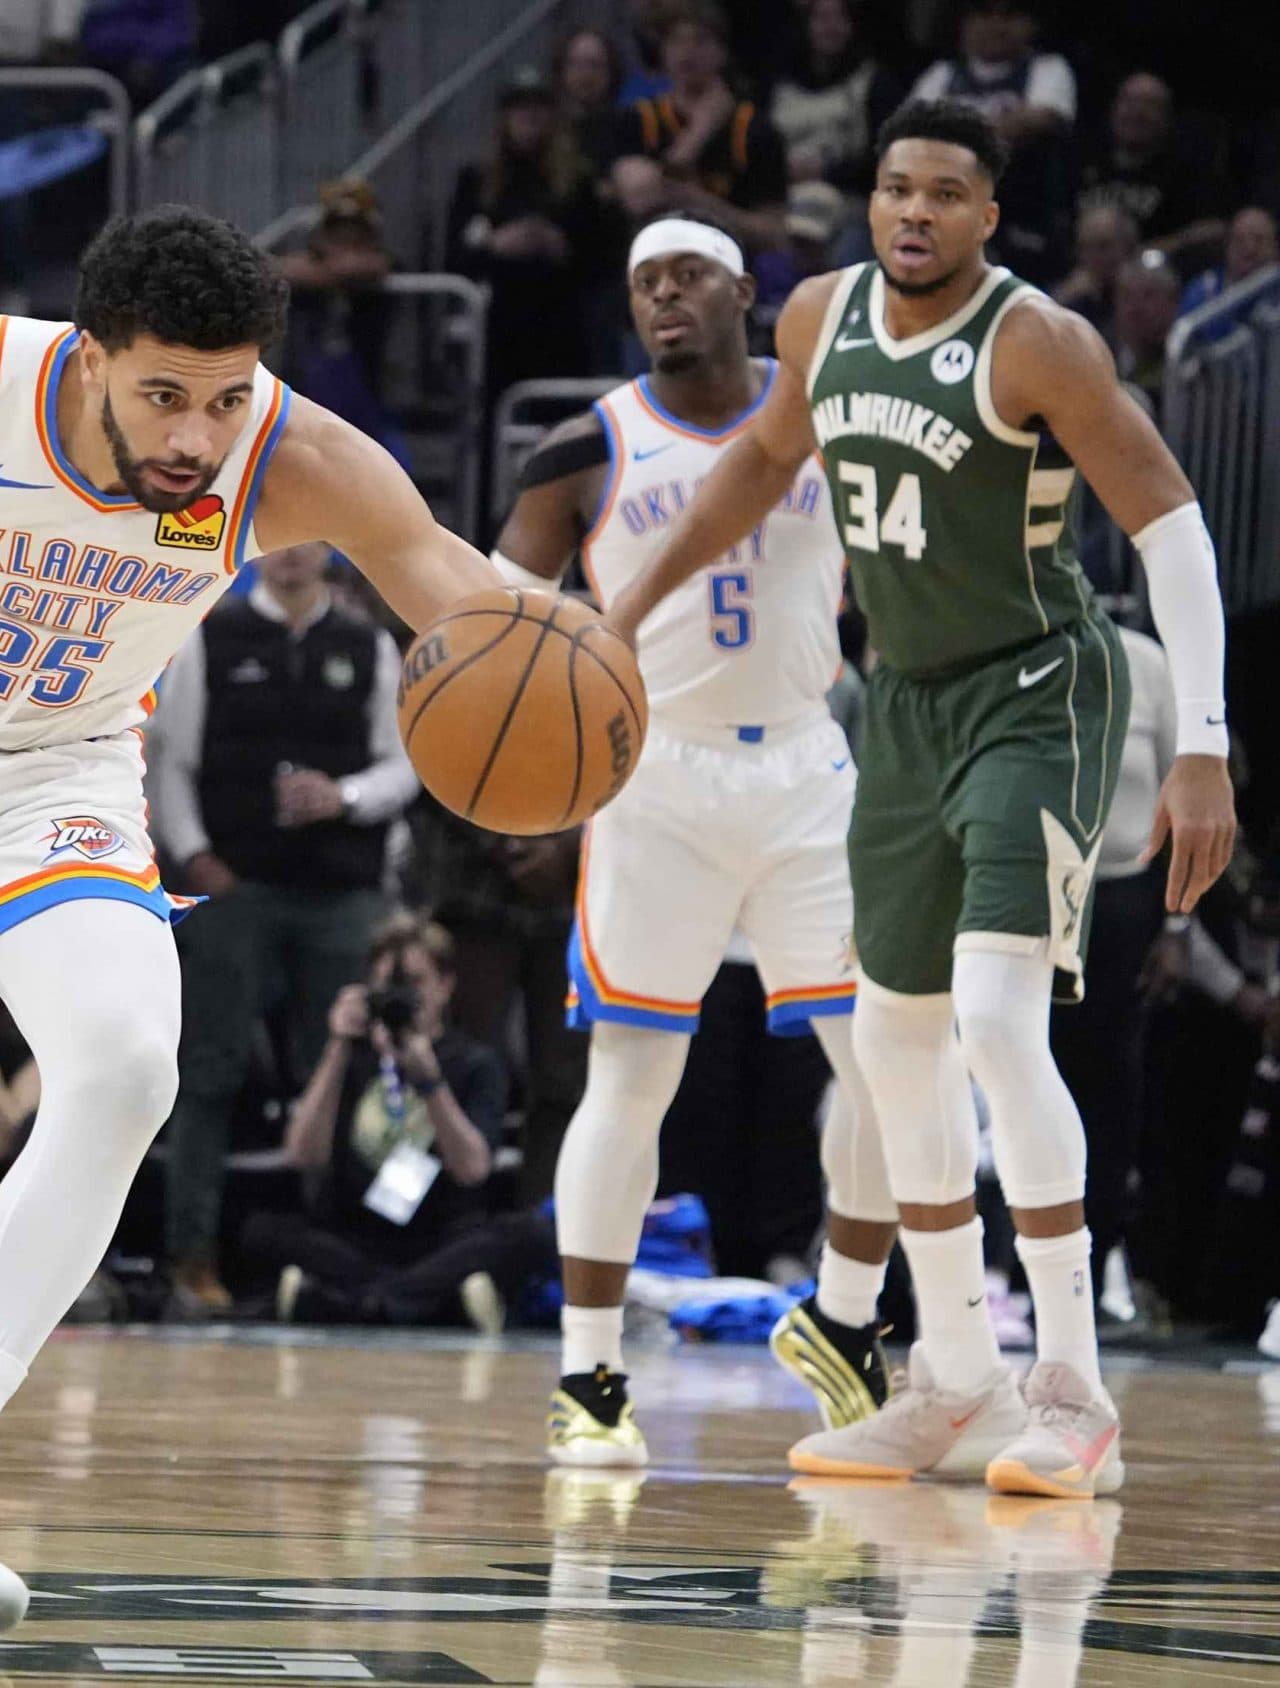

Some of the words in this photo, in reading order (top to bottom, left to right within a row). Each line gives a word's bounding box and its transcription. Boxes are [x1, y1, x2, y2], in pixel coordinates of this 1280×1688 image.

[837, 459, 928, 561] 34
[709, 568, 756, 652] 5
[51, 824, 112, 850] OKC
